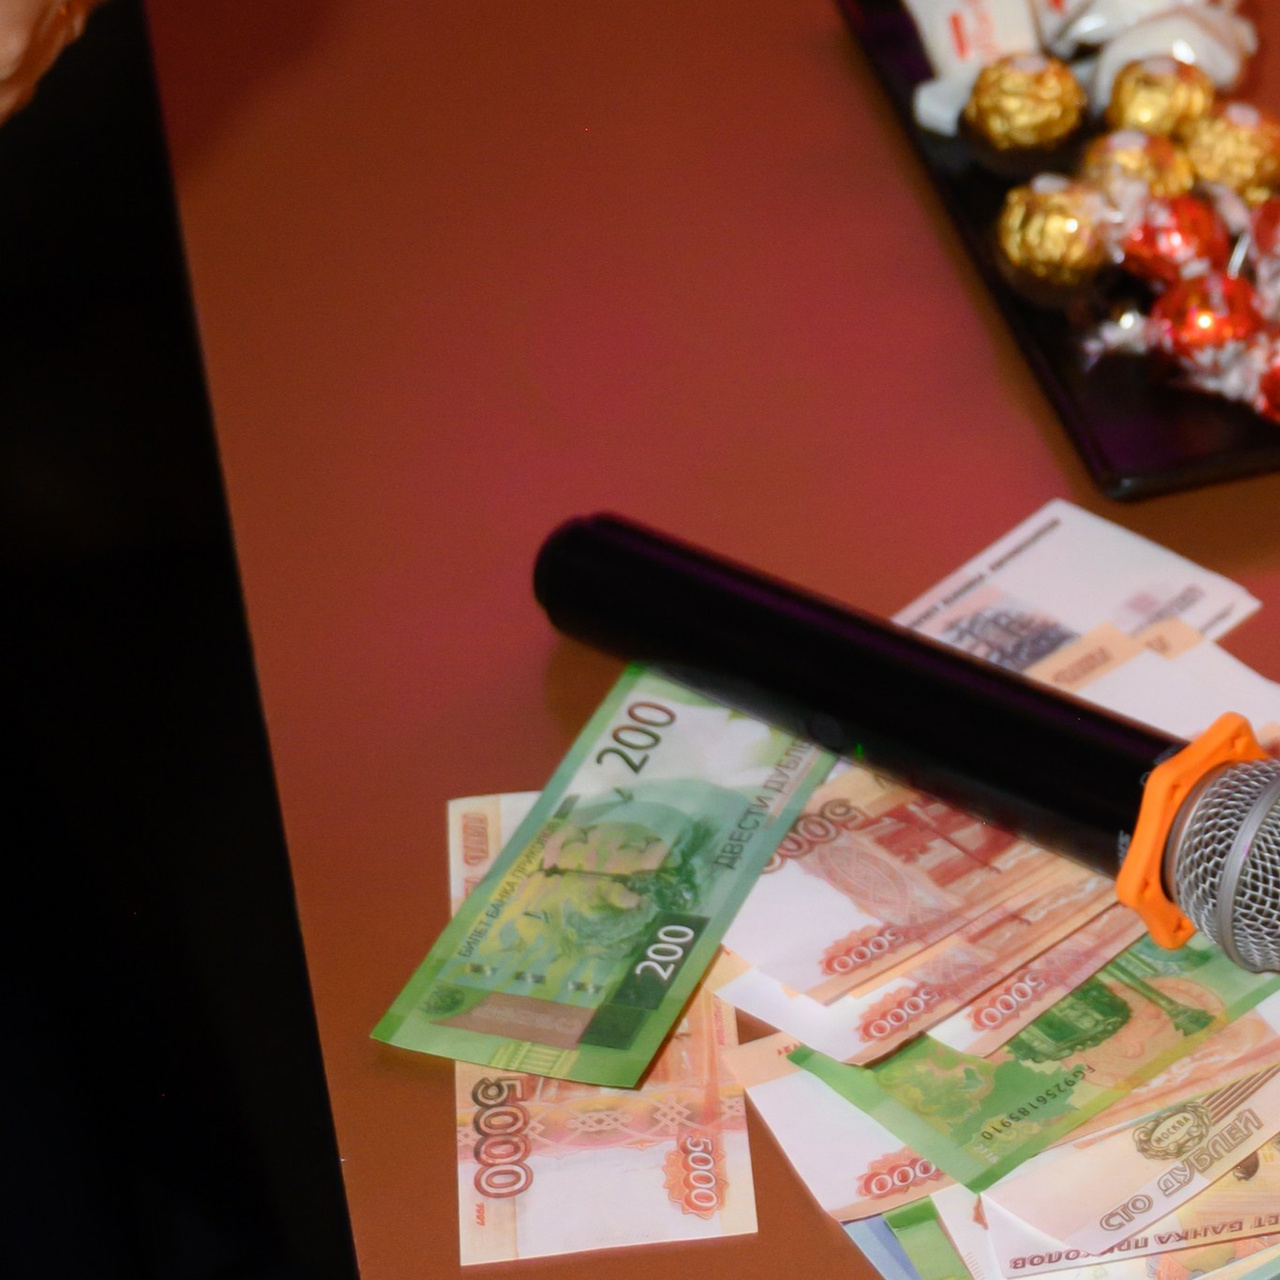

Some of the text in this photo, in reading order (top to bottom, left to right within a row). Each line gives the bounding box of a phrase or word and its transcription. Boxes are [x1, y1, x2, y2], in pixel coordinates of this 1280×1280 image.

[595, 701, 677, 775] 200
[715, 792, 772, 870] ДВЕСТИ
[458, 921, 491, 958] БИЛЕТ
[635, 925, 695, 981] 200
[833, 926, 905, 974] 5000
[869, 987, 939, 1038] 5000
[981, 972, 1046, 1026] 5000
[470, 1076, 534, 1199] 5000
[1151, 1113, 1191, 1145] МОСКВА
[685, 1135, 719, 1210] 5000
[869, 1157, 937, 1198] 000
[1099, 1107, 1264, 1233] СТО ДУБЛЕЙ
[1155, 1219, 1245, 1247] БАНКА
